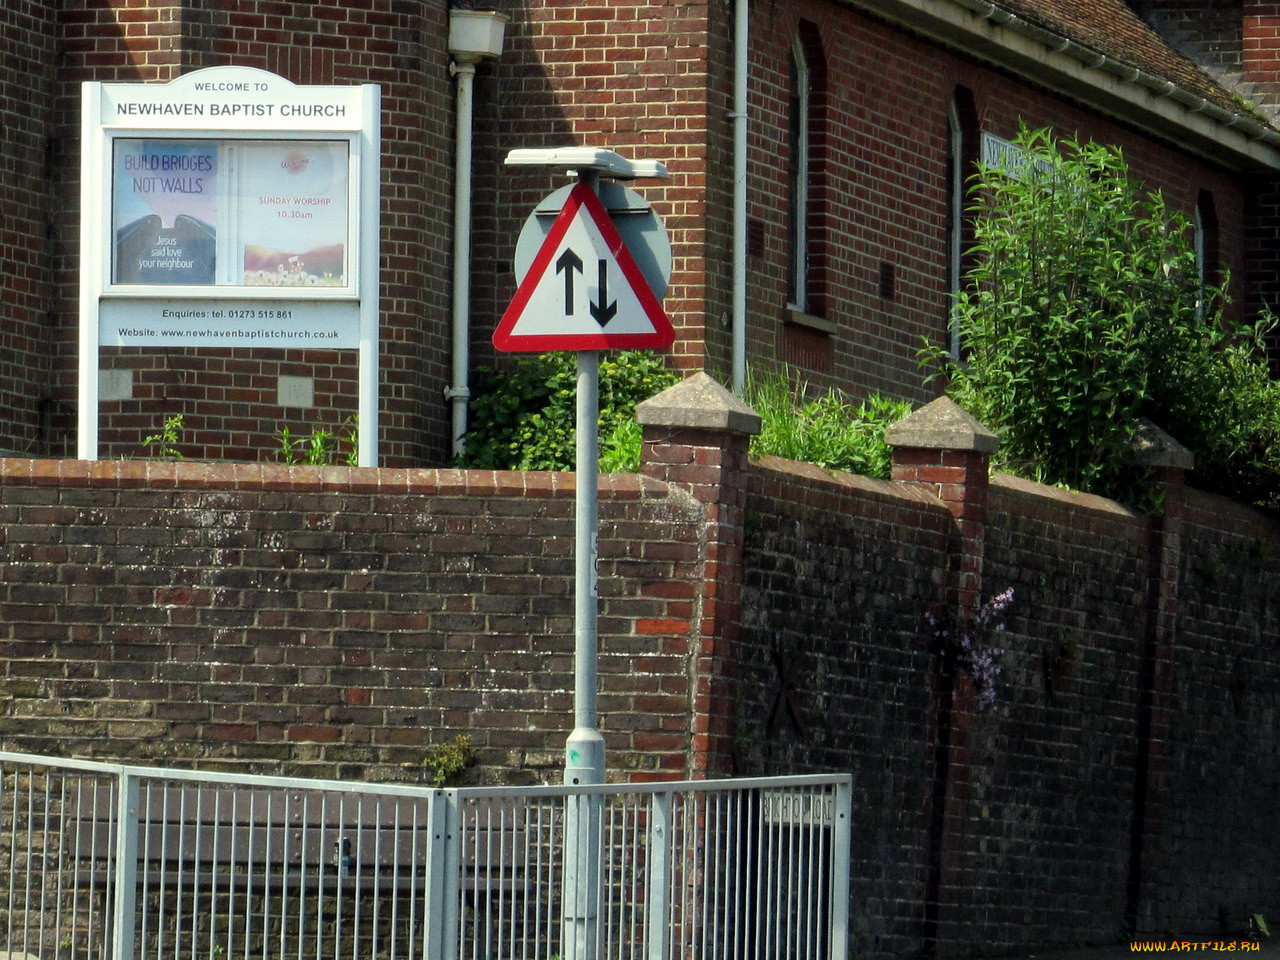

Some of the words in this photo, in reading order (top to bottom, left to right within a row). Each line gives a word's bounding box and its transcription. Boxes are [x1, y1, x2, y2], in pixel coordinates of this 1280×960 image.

[195, 82, 250, 92] WELCOME
[254, 83, 269, 92] TO
[117, 103, 204, 116] NEWHAVEN
[210, 104, 275, 117] BAPTIST
[280, 104, 346, 117] CHURCH
[124, 154, 160, 171] BUILD
[162, 155, 212, 172] BRIDGES
[133, 177, 157, 193] NOT
[160, 178, 203, 194] WALLS
[259, 197, 291, 205] SUNDAY
[294, 197, 331, 206] WORSHIP
[277, 211, 313, 219] 10.30am
[156, 236, 177, 246] Jesus
[151, 247, 166, 257] said
[167, 247, 182, 257] love
[138, 260, 157, 270] your
[157, 259, 194, 270] neighbour
[162, 309, 209, 320] Enquiries:
[211, 309, 226, 318] tel.
[228, 309, 256, 319] 01273
[258, 310, 274, 319] 515
[276, 310, 292, 319] 861
[118, 328, 158, 337] Website:
[160, 329, 339, 339] www.newhavenbaptistchurch.co.uk
